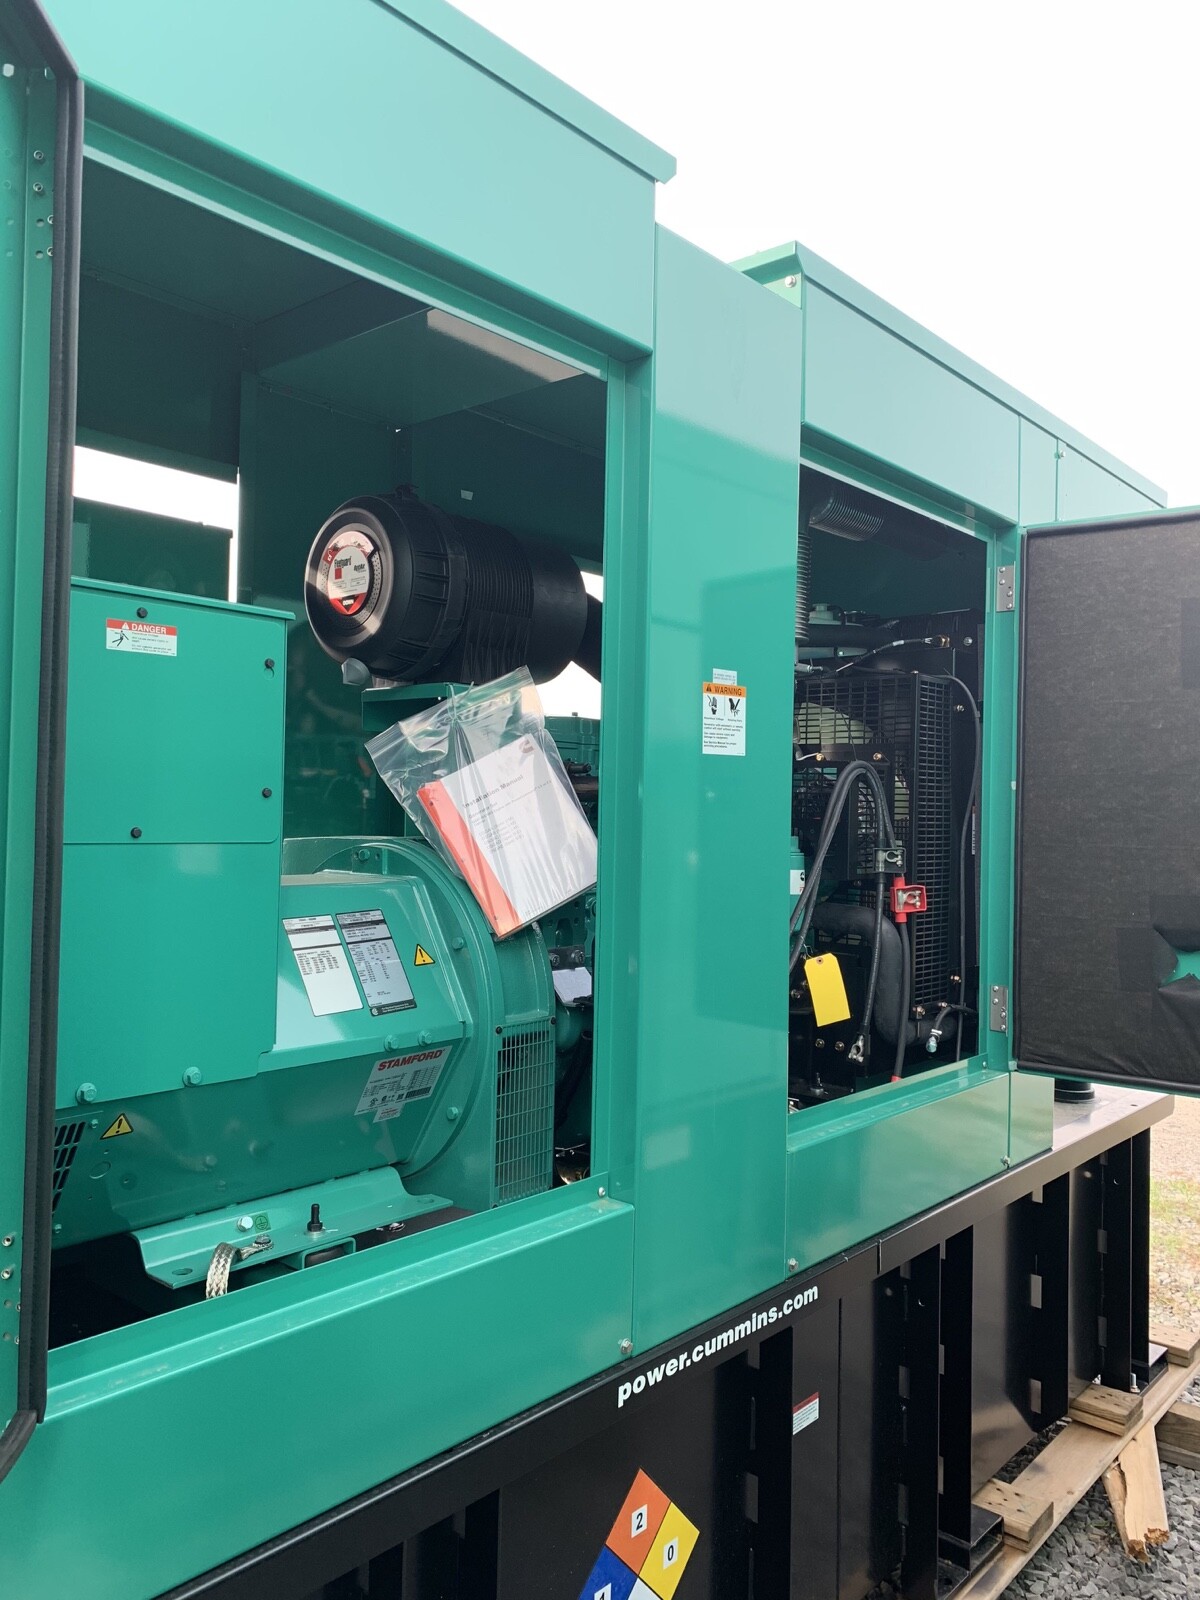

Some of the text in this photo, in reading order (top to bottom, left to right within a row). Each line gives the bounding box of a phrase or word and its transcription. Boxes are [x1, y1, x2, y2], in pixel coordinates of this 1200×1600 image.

[131, 623, 167, 634] DANGER
[714, 686, 742, 696] WARNING
[462, 787, 500, 809] Installation
[500, 774, 524, 790] Manual
[378, 1049, 443, 1071] STAMFORD
[617, 1285, 819, 1409] power.cummins.com
[635, 1512, 643, 1531] 2
[667, 1545, 674, 1562] 0
